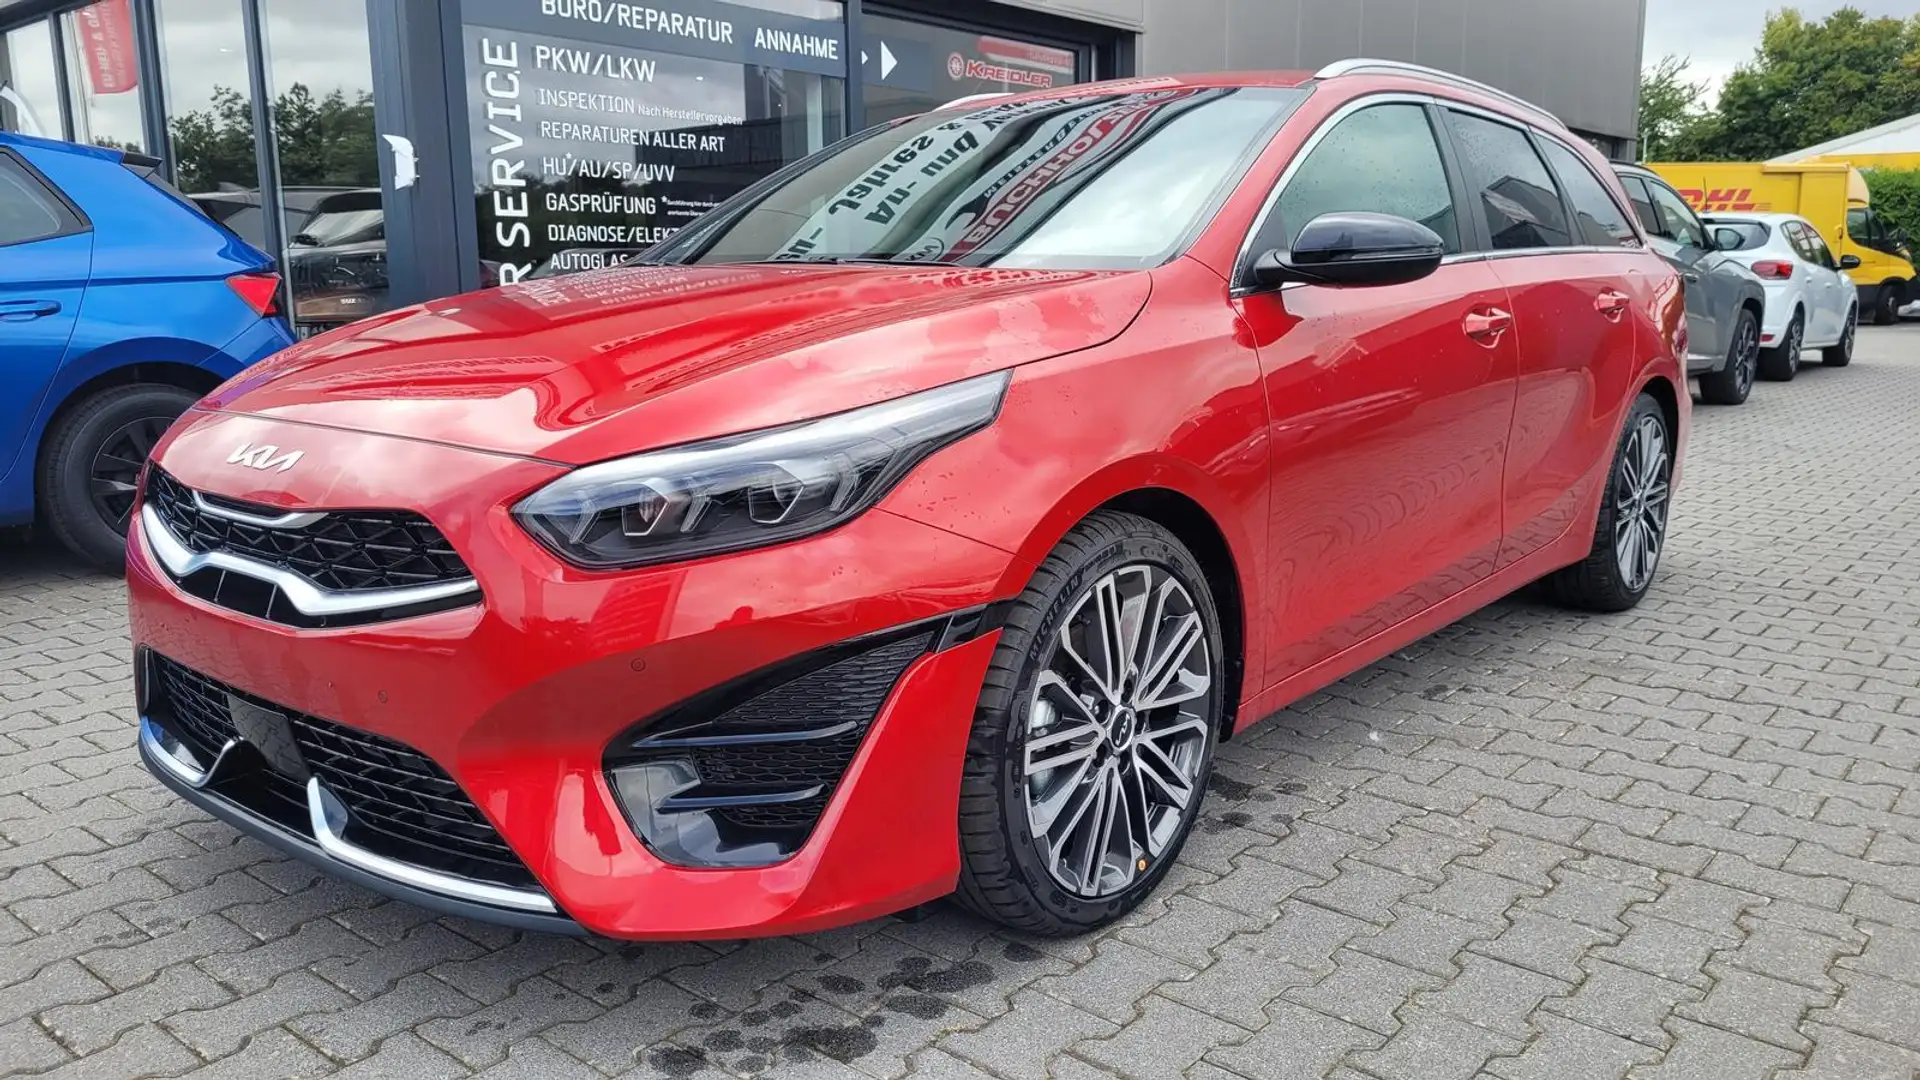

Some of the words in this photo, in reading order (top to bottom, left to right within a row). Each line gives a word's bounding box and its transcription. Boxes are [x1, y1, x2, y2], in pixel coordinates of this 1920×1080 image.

[754, 27, 838, 60] ANNAHME
[535, 45, 656, 82] PKW/LKW
[965, 60, 1052, 88] KREIDLER
[539, 88, 634, 114] INSPEKTION
[638, 104, 661, 117] Nach
[662, 107, 743, 126] Herstellervorgaben
[482, 37, 531, 247] SERVICE
[540, 121, 649, 146] REPARATUREN
[653, 131, 696, 150] ALLER
[700, 136, 725, 152] ART
[545, 192, 656, 214] GASPRÜFUNG
[1677, 188, 1757, 211] DHL
[226, 442, 306, 475] KIA
